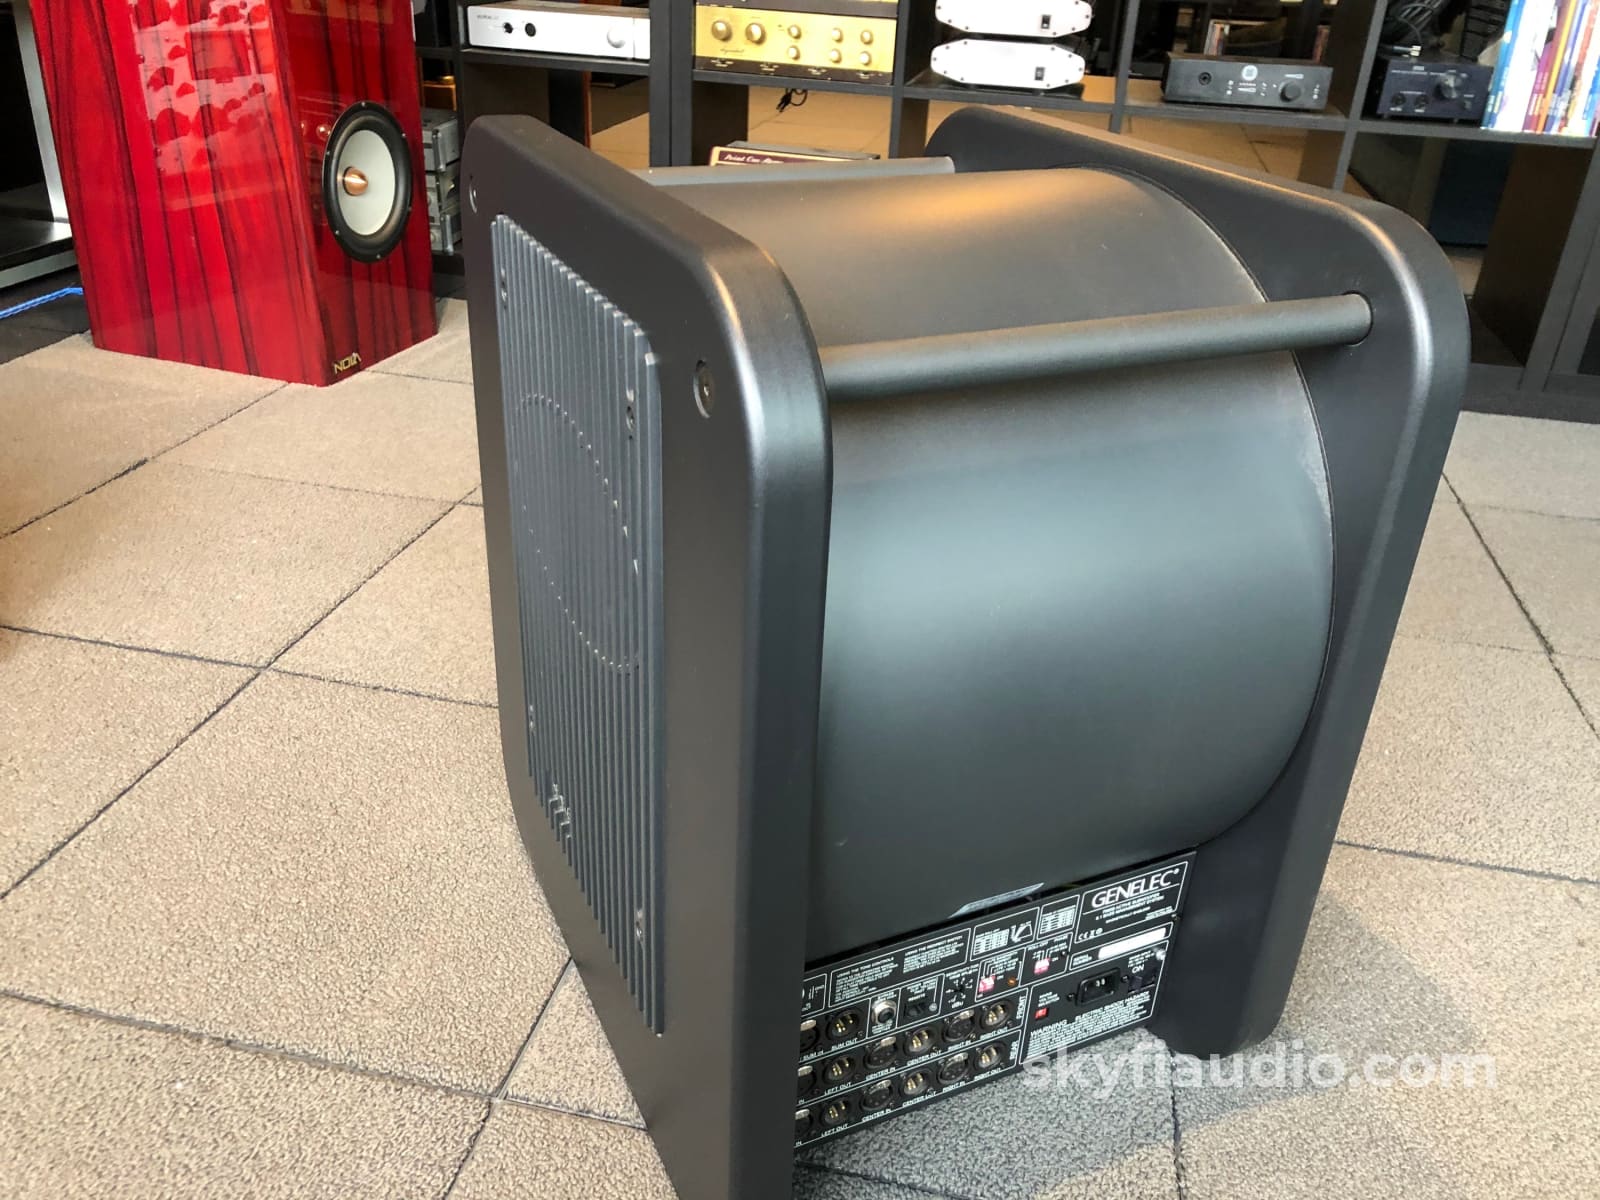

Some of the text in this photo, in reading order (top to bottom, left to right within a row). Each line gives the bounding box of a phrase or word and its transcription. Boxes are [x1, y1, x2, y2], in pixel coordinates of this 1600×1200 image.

[334, 352, 362, 374] NOLA
[1091, 869, 1175, 908] GENELEC
[1132, 964, 1145, 974] ON
[1031, 1020, 1067, 1038] WARNING
[845, 1037, 858, 1047] OUT
[824, 1081, 852, 1096] LEFT OUT
[820, 1123, 849, 1138] LEFT OUT
